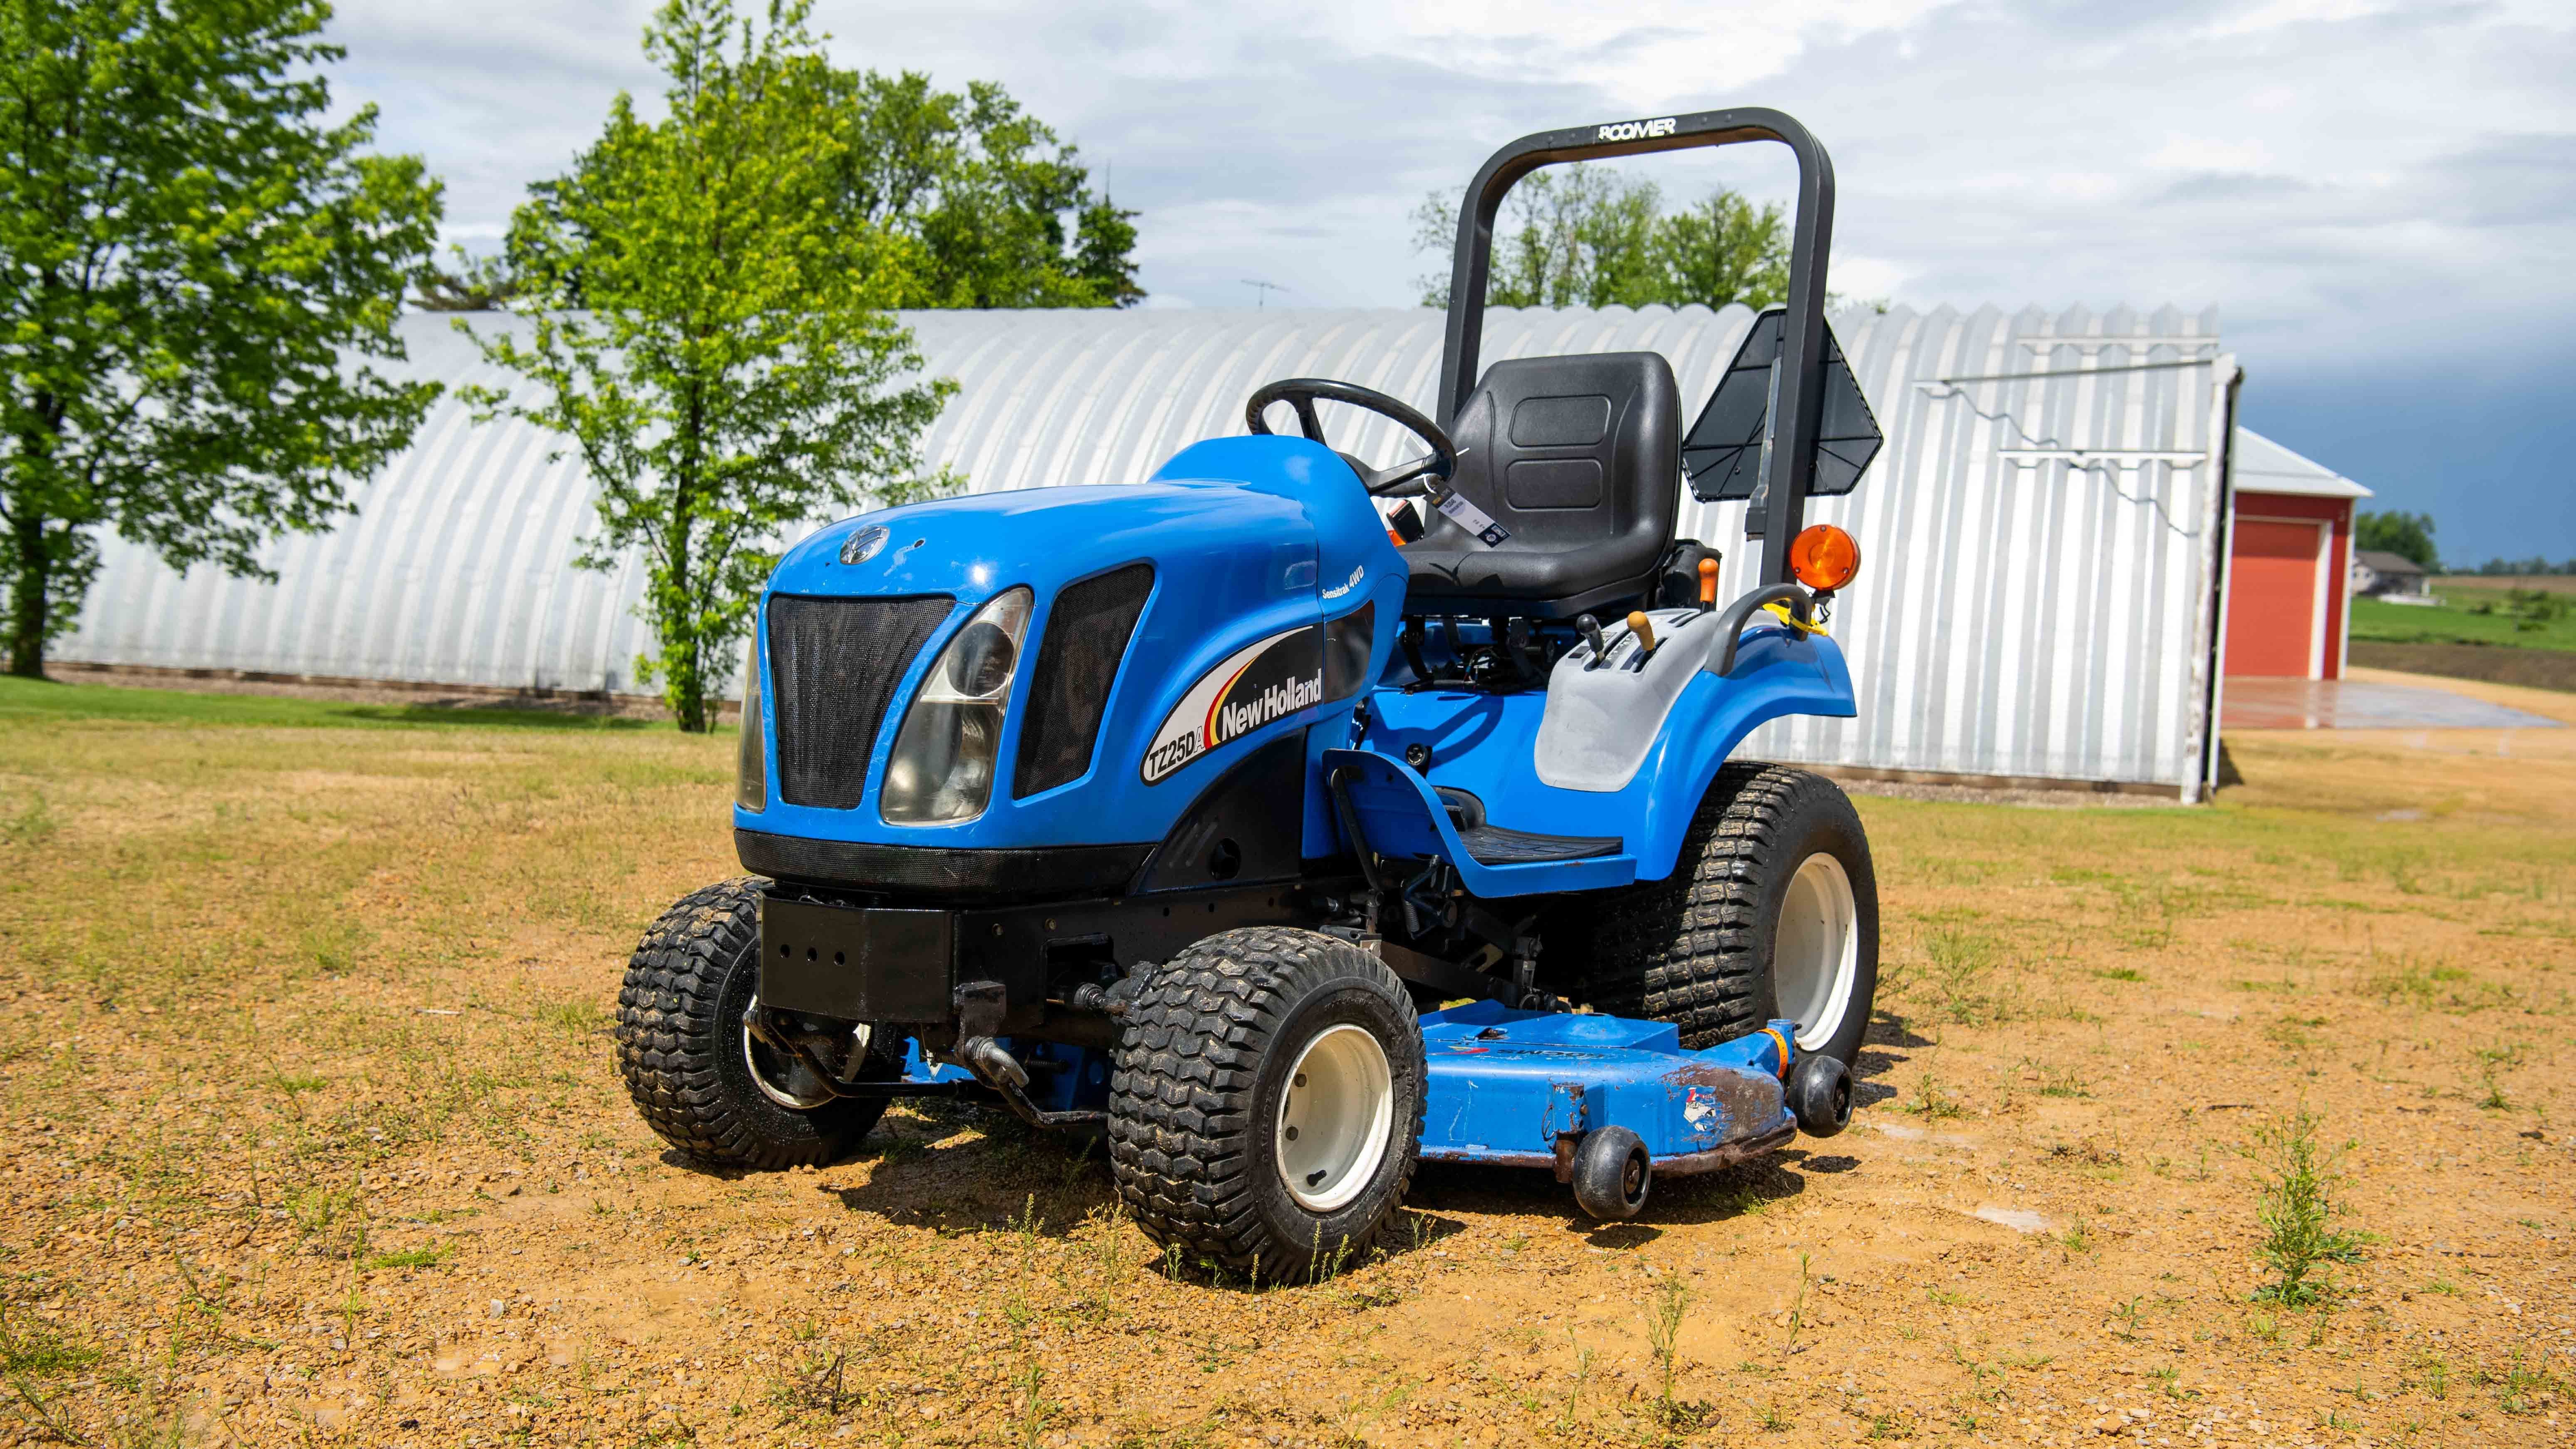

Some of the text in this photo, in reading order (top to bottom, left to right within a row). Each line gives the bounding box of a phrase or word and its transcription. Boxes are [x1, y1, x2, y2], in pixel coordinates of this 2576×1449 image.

[1322, 565, 1364, 599] Sensitrak 4WD
[1222, 668, 1321, 740] New Holland
[1149, 726, 1205, 778] TZ25DA
